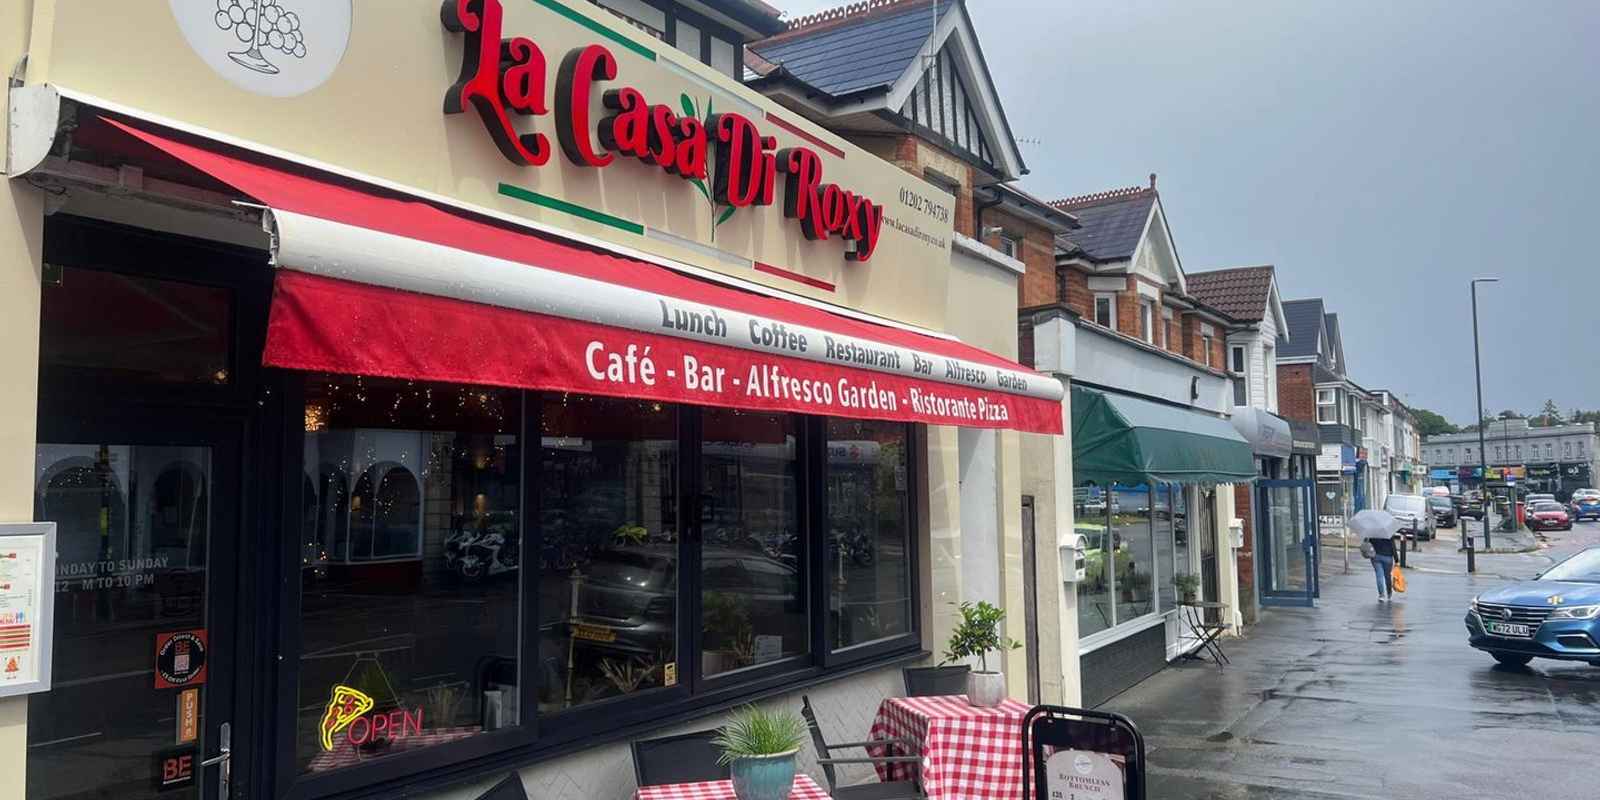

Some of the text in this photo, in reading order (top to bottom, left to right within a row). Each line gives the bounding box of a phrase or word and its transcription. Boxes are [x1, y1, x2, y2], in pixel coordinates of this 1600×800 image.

[441, 0, 883, 262] La Casa Di Roxy
[899, 186, 951, 224] 01202 794738
[659, 299, 1029, 393] Lunch Coffee Restaurant Bar Alfresco Garden
[584, 340, 656, 386] Café
[682, 353, 726, 394] Bar
[745, 364, 834, 406] Alfresco
[837, 377, 898, 412] Garden
[909, 387, 977, 421] Ristorante
[978, 395, 1010, 422] Pizza
[96, 576, 113, 590] TO
[115, 575, 132, 589] 10
[134, 572, 155, 586] PM
[98, 559, 115, 574] TO
[118, 556, 169, 572] SUNDAY
[347, 706, 422, 745] OPEN
[162, 755, 192, 780] BE
